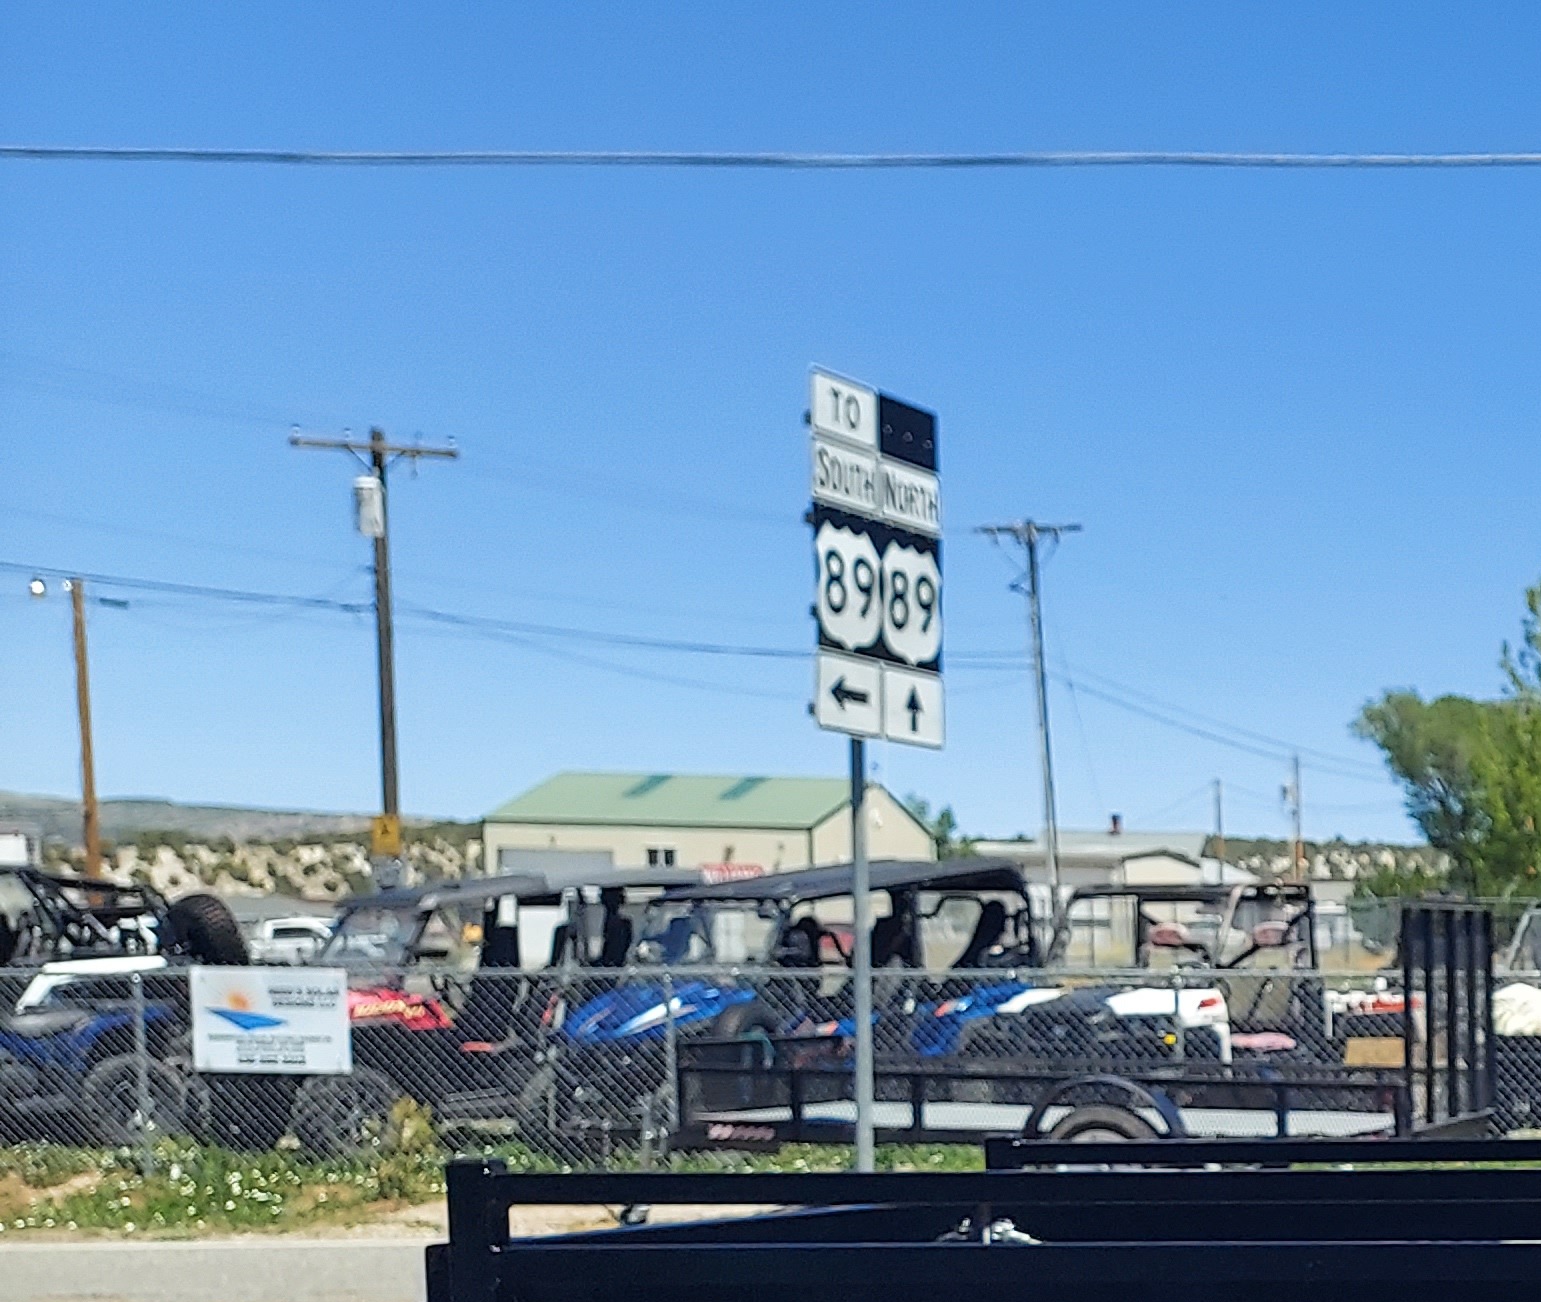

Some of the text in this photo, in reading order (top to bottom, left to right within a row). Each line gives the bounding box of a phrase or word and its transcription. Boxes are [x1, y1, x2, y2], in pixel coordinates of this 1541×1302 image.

[829, 386, 860, 431] TO
[817, 448, 875, 501] SOUTH
[885, 472, 938, 518] NORTH
[825, 549, 876, 619] 89
[890, 570, 937, 633] 89
